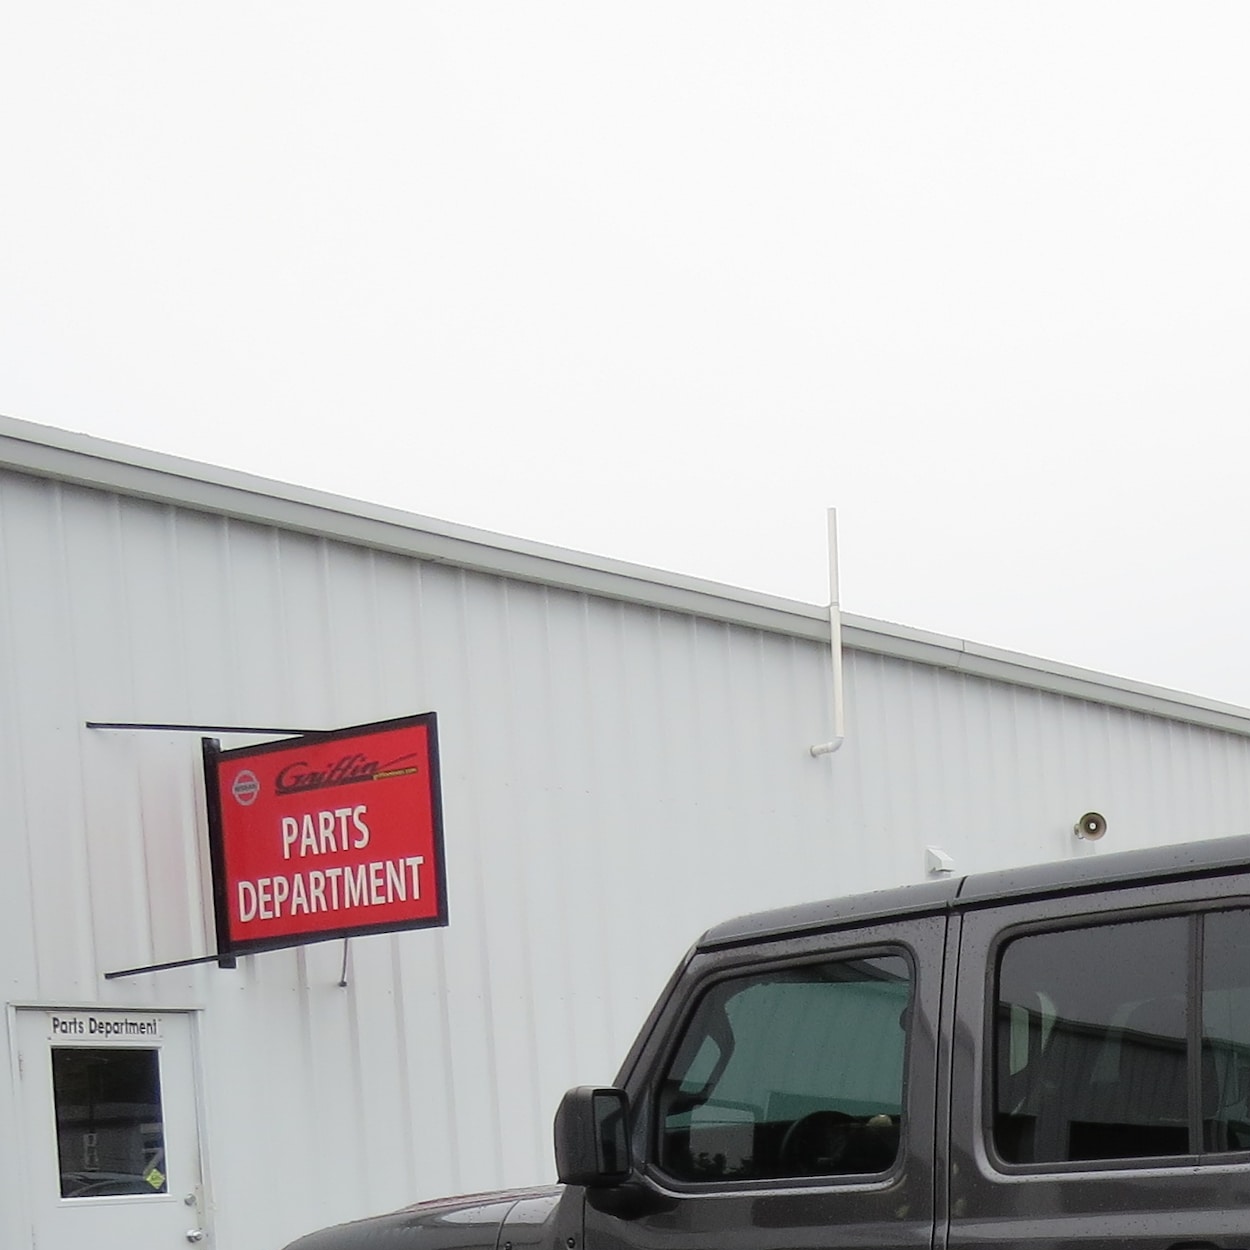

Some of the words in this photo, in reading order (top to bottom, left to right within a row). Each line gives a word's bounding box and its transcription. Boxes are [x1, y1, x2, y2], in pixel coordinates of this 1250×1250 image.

[281, 804, 370, 860] PARTS
[237, 856, 424, 923] DEPARTMENT
[52, 1017, 84, 1034] Parts
[88, 1017, 157, 1038] Department
